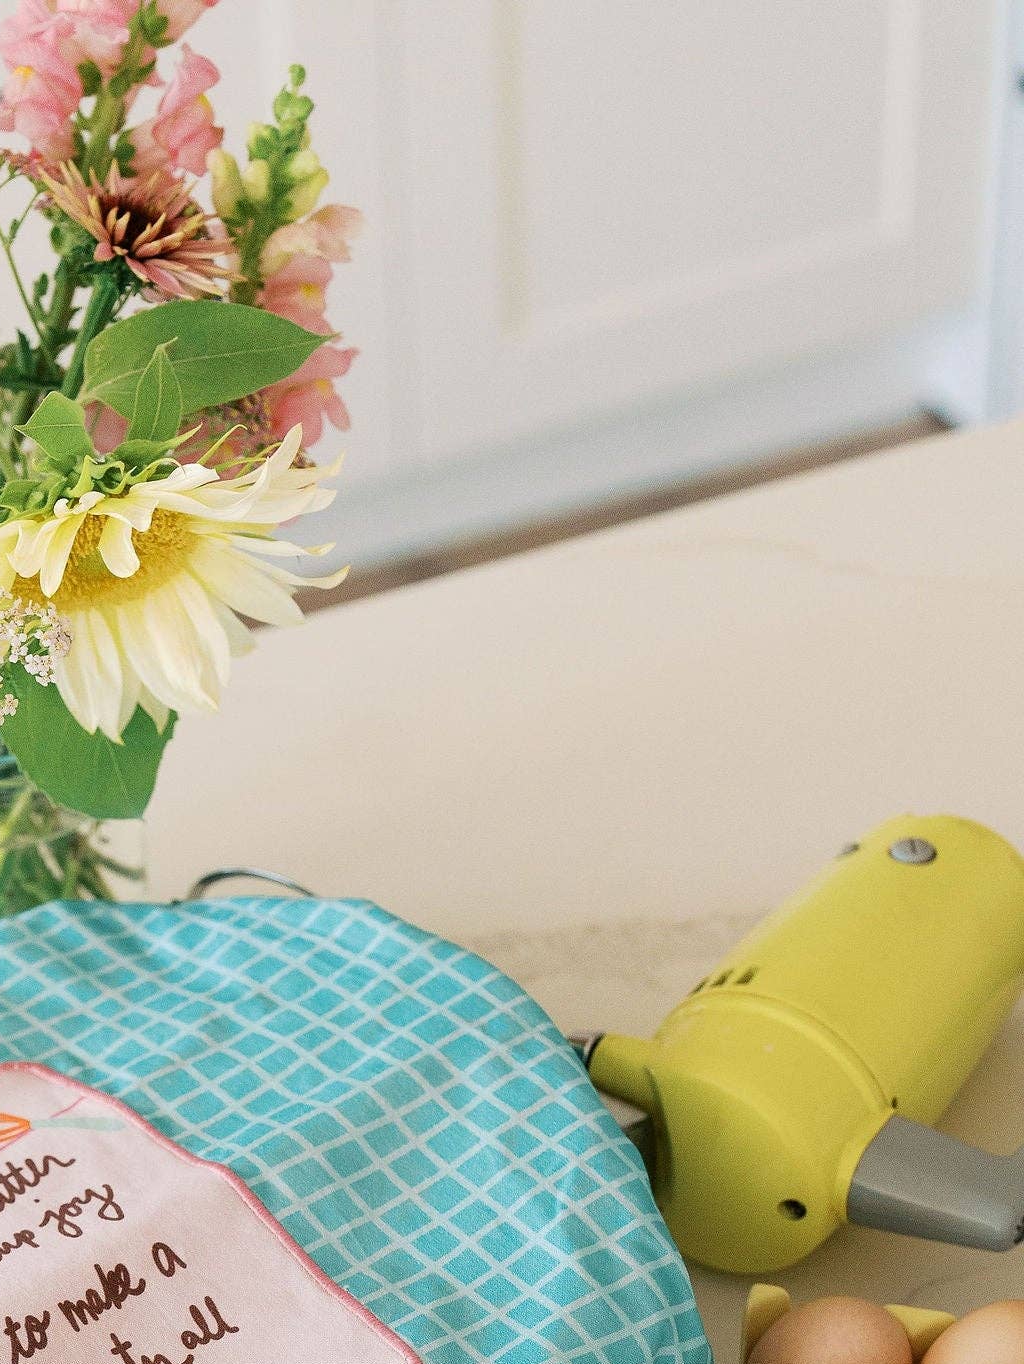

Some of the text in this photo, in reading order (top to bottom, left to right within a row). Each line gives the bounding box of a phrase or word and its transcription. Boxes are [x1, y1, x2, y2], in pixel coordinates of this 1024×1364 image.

[33, 1183, 125, 1240] joy
[56, 1262, 147, 1333] make
[151, 1241, 188, 1278] a
[180, 1295, 240, 1350] all
